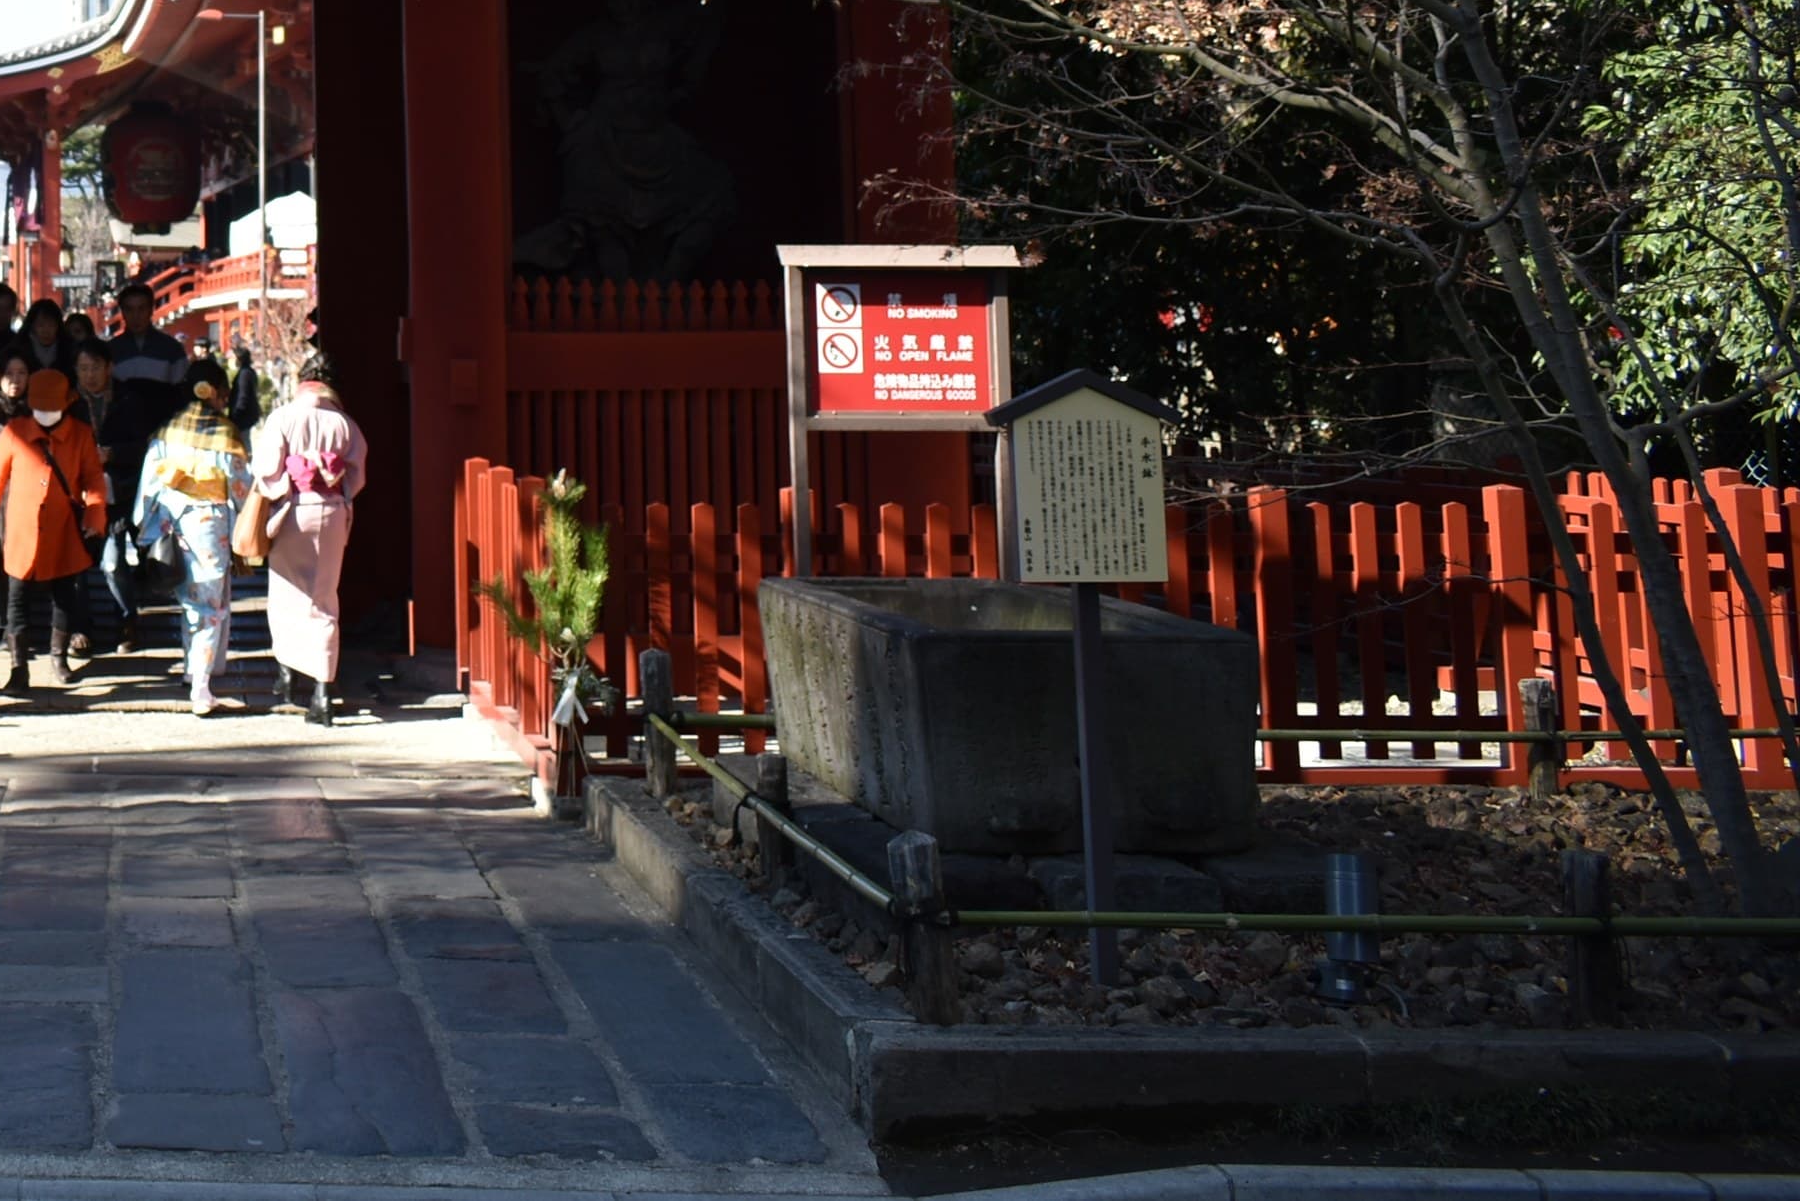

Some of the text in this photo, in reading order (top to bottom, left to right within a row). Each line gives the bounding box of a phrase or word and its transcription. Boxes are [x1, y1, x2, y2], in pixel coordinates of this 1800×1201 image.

[887, 308, 958, 319] NO SMOKING
[874, 351, 974, 362] NO OPEN FLAME
[874, 389, 977, 401] NO DANGEROUS GOODS
